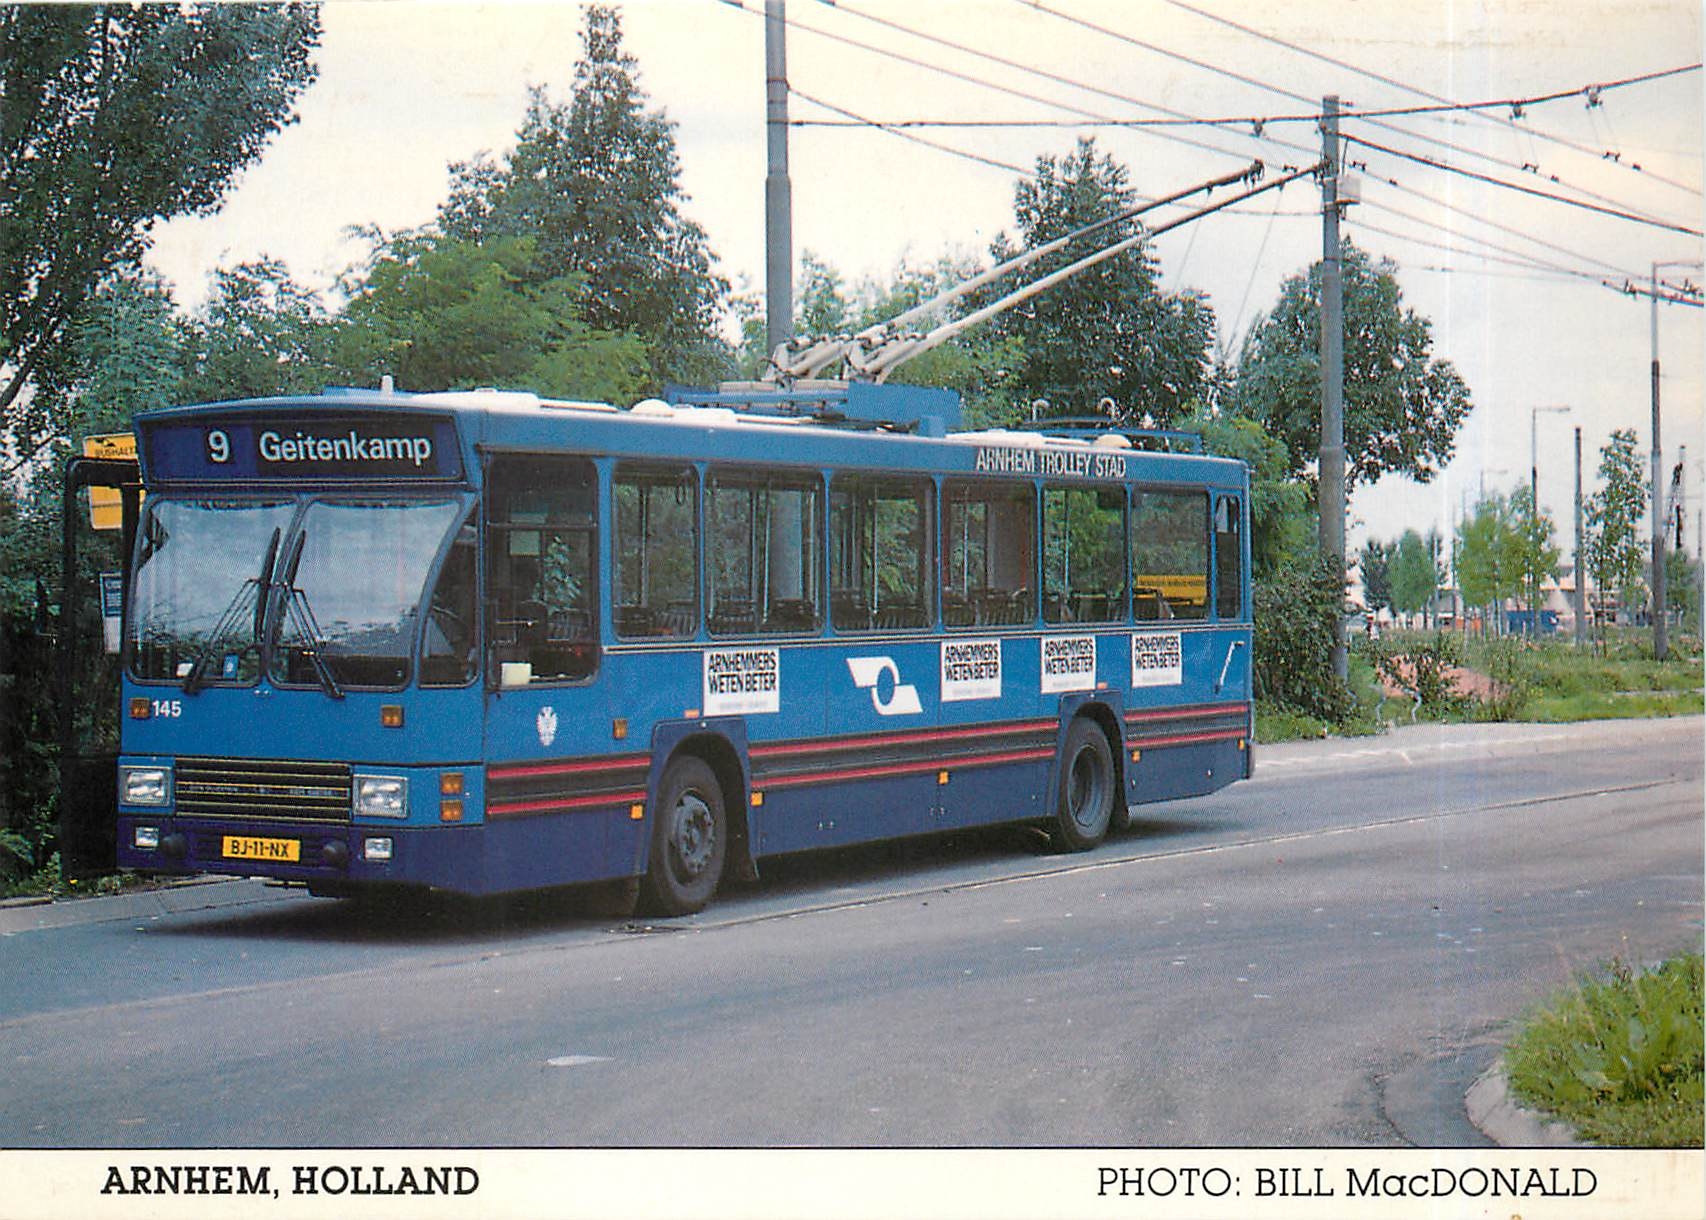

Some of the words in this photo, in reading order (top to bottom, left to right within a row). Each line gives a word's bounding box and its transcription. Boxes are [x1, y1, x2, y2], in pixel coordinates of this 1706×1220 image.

[208, 431, 229, 462] 9
[259, 431, 431, 466] Geitenkamp
[976, 448, 1035, 473] ARNHEM
[1040, 452, 1091, 475] TROLLEY
[1095, 456, 1126, 478] STAD
[709, 652, 776, 672] ARNHEMMERS
[709, 673, 744, 694] WETEN
[745, 672, 776, 692] BETER
[152, 700, 182, 718] 145
[231, 839, 289, 857] BJ-11-NX
